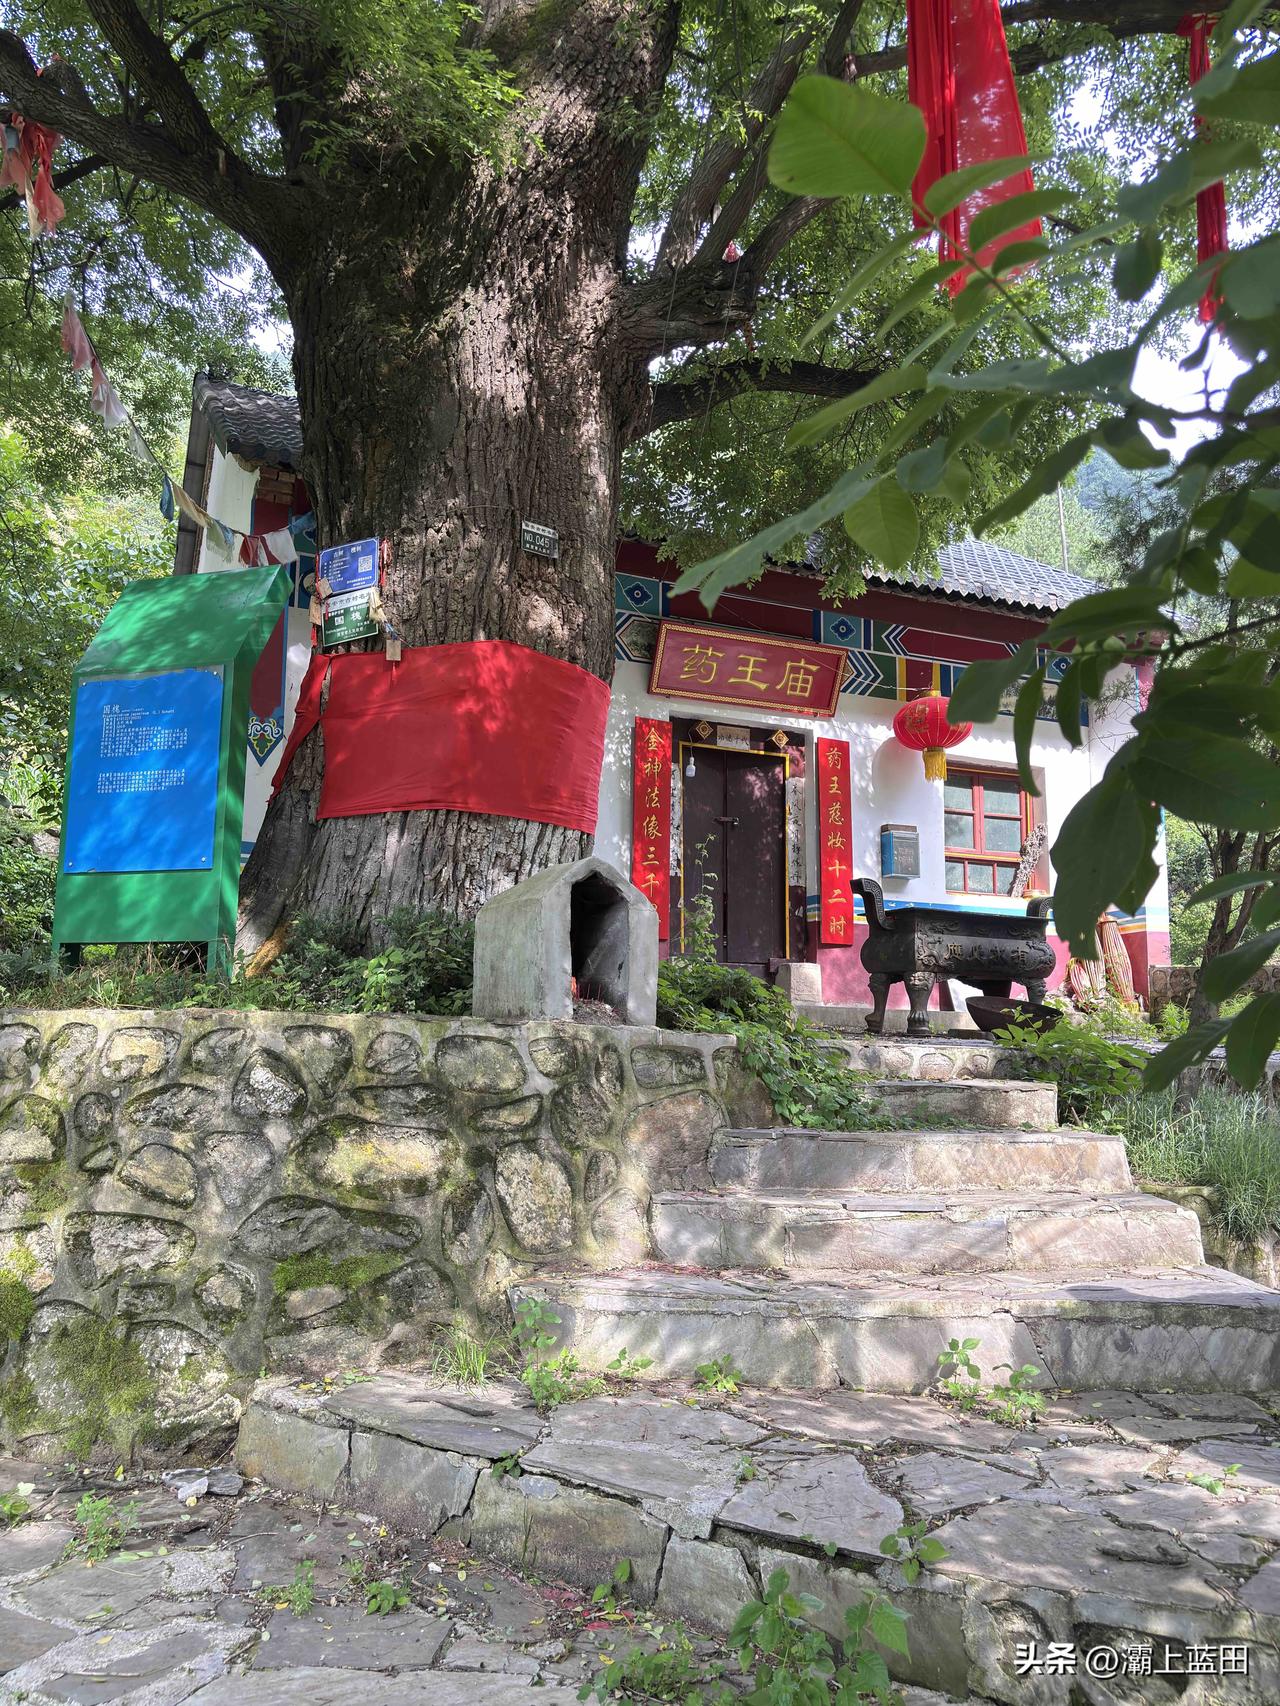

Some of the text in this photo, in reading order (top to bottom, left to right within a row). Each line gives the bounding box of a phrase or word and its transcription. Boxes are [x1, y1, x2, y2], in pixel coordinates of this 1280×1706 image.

[680, 644, 821, 697] 药王庙
[641, 727, 665, 922] 金神法像三千
